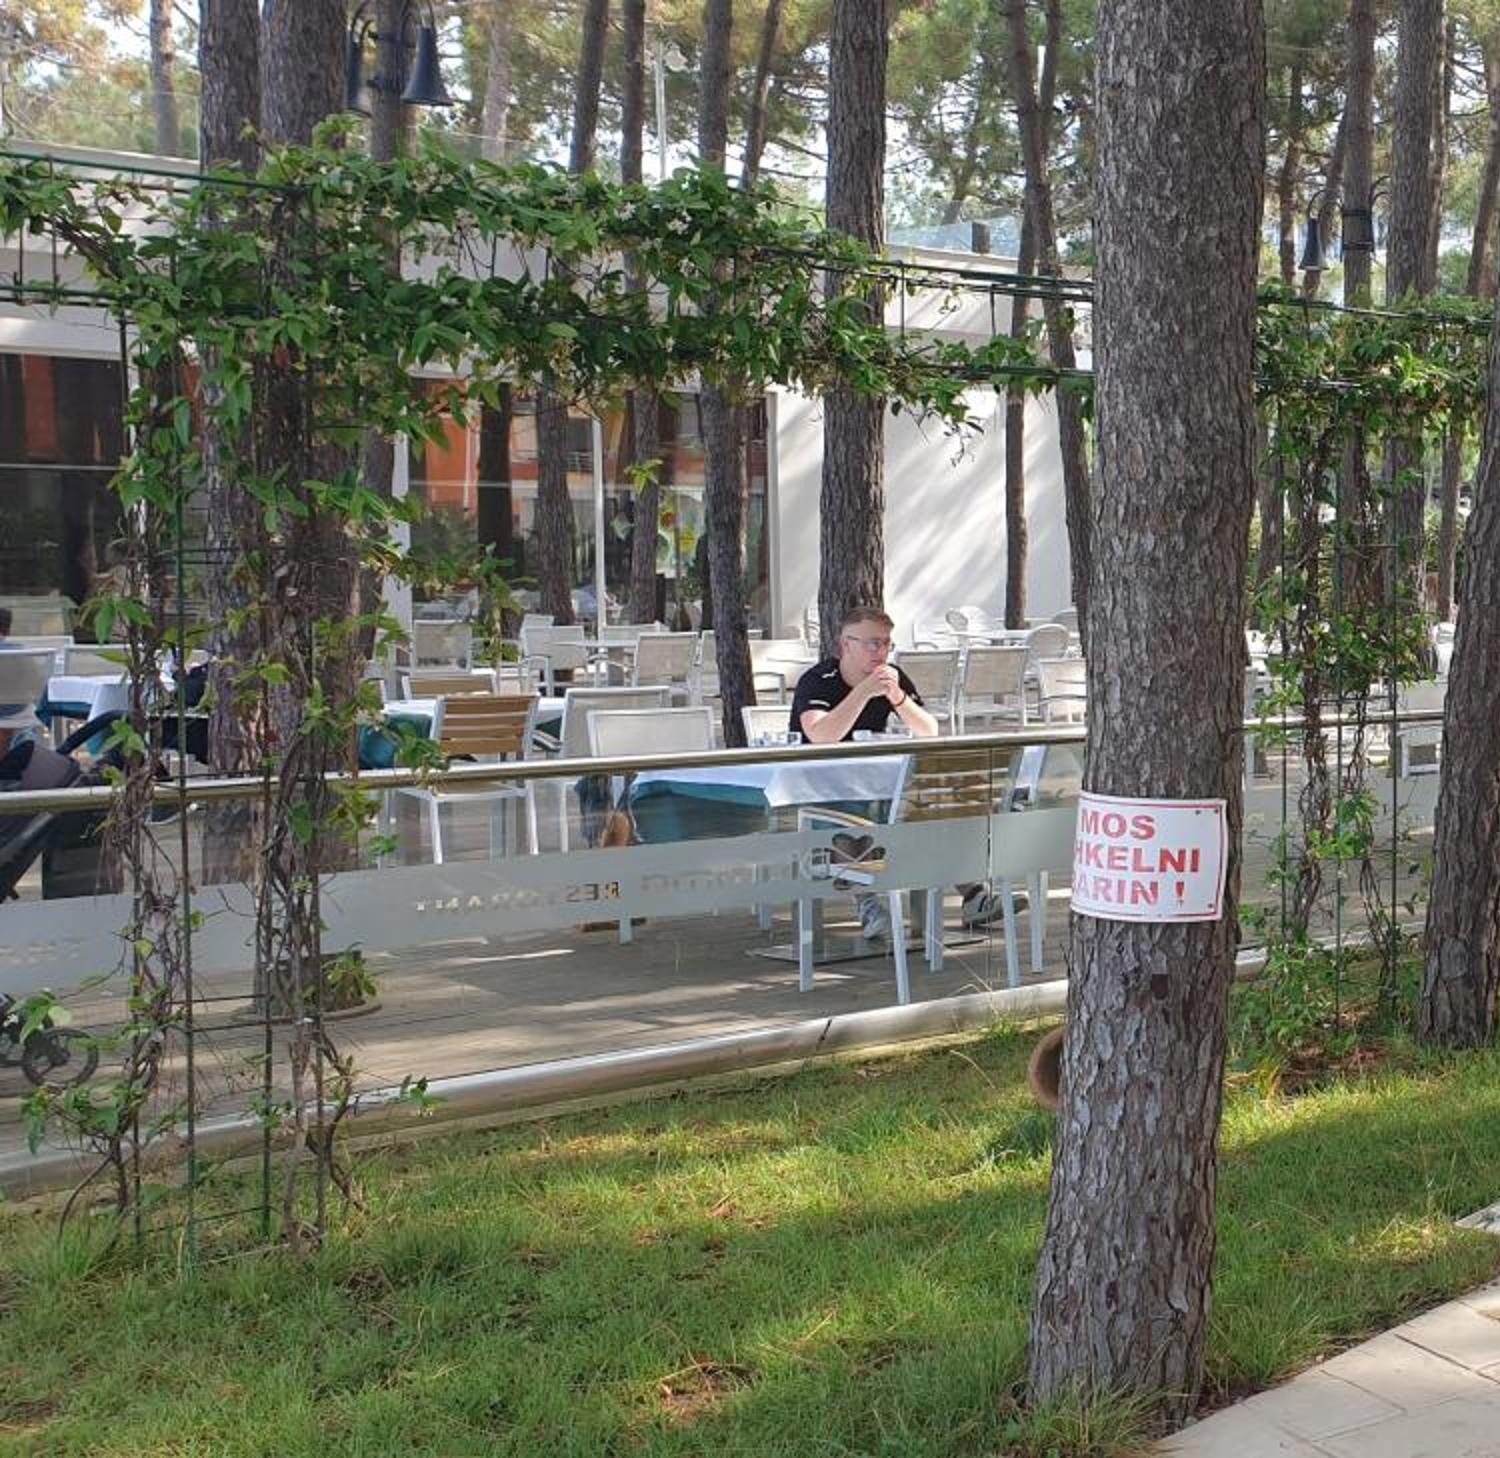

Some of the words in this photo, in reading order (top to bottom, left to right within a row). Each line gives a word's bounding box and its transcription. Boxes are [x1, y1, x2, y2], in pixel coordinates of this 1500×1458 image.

[1081, 808, 1155, 840] MOS
[1075, 839, 1199, 873] HKELNI
[1074, 870, 1158, 905] ARIN
